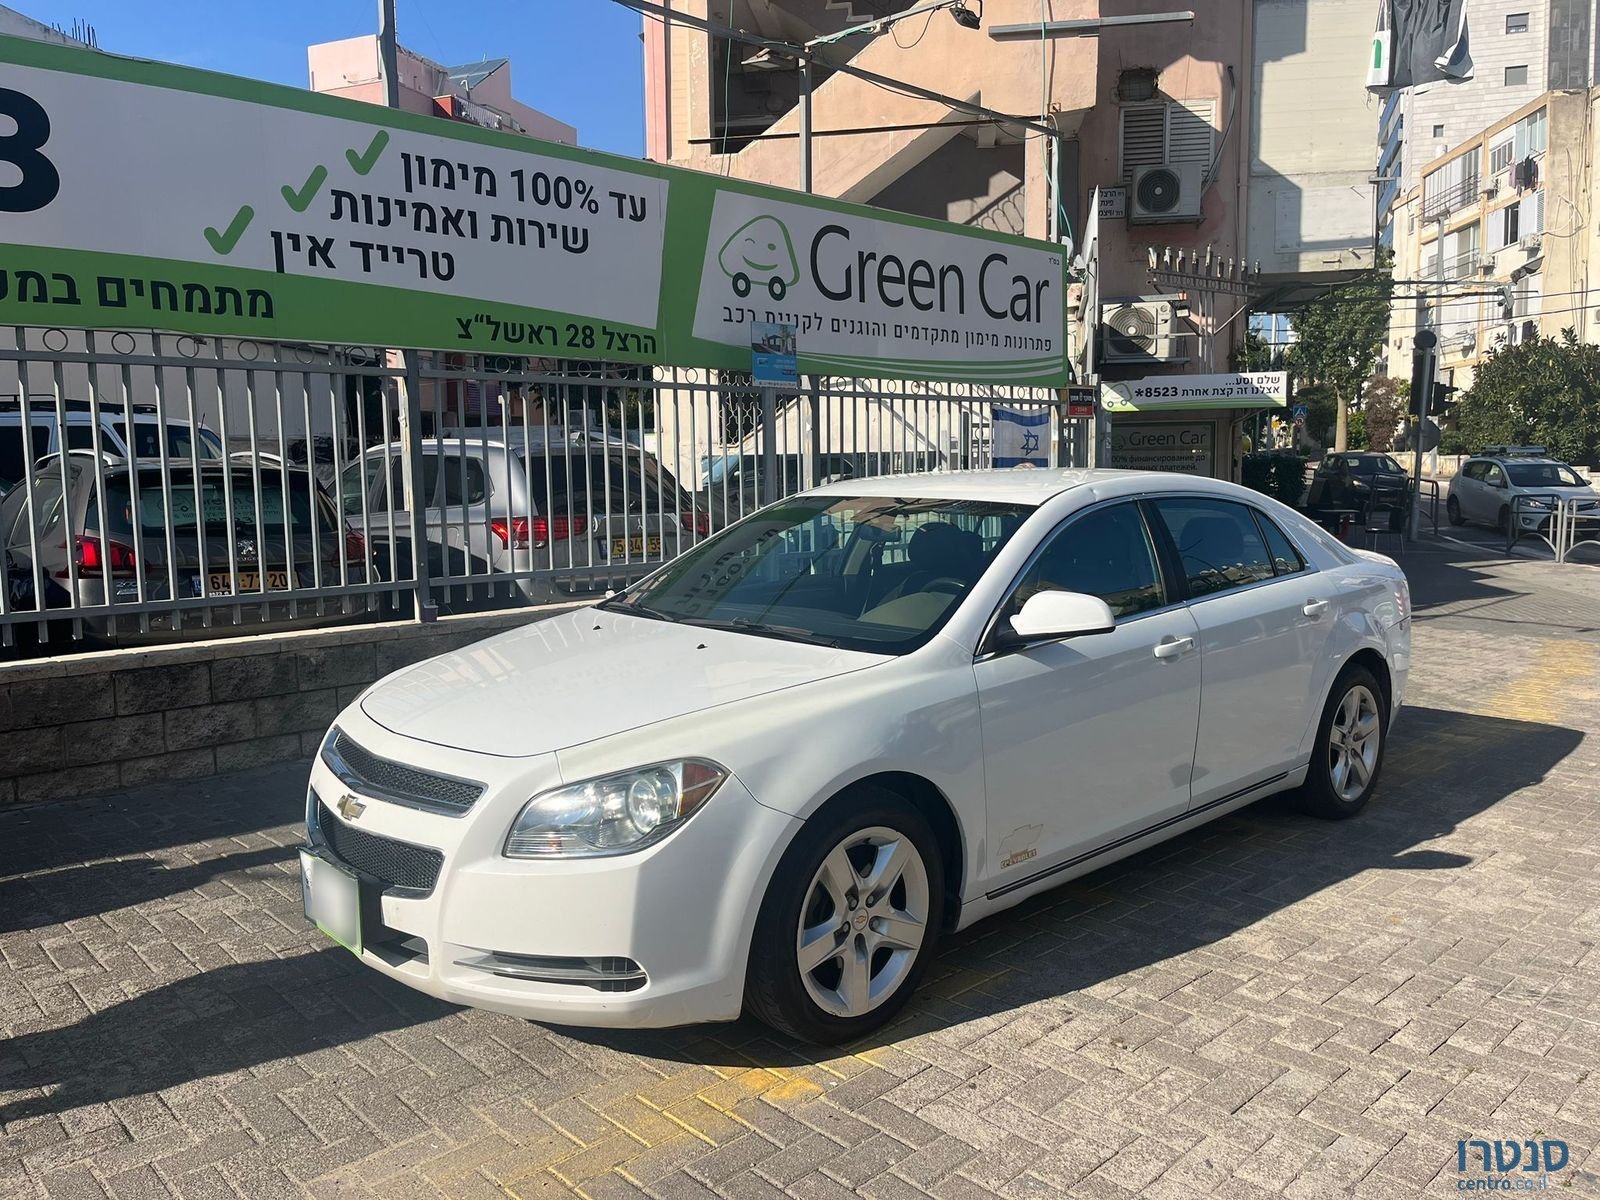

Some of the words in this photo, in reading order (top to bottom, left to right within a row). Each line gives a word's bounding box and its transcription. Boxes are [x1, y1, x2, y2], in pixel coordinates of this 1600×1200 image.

[401, 152, 497, 197] מימון
[510, 169, 599, 214] 100%
[330, 188, 478, 239] ואמינות
[609, 191, 646, 222] עד
[490, 213, 589, 253] שירות
[270, 230, 336, 273] אין
[350, 240, 455, 281] טרייד
[810, 224, 965, 315] Green
[978, 253, 1050, 323] Car
[0, 269, 81, 306] במ
[97, 275, 274, 319] מתמחים
[723, 305, 757, 325] רכב
[830, 316, 887, 338] והוגנים
[565, 323, 595, 348] 28
[602, 326, 657, 354] הרצל
[894, 323, 959, 345] מתקדמים
[965, 331, 1000, 349] מימון
[1004, 334, 1052, 352] פתרונות
[1181, 388, 1209, 396] אחרת
[1212, 387, 1233, 397] קצת
[1236, 386, 1248, 395] זה
[1251, 386, 1280, 395] אצלנו
[1257, 375, 1280, 385] שלם
[1129, 431, 1176, 446] Green
[1180, 430, 1206, 444] Car
